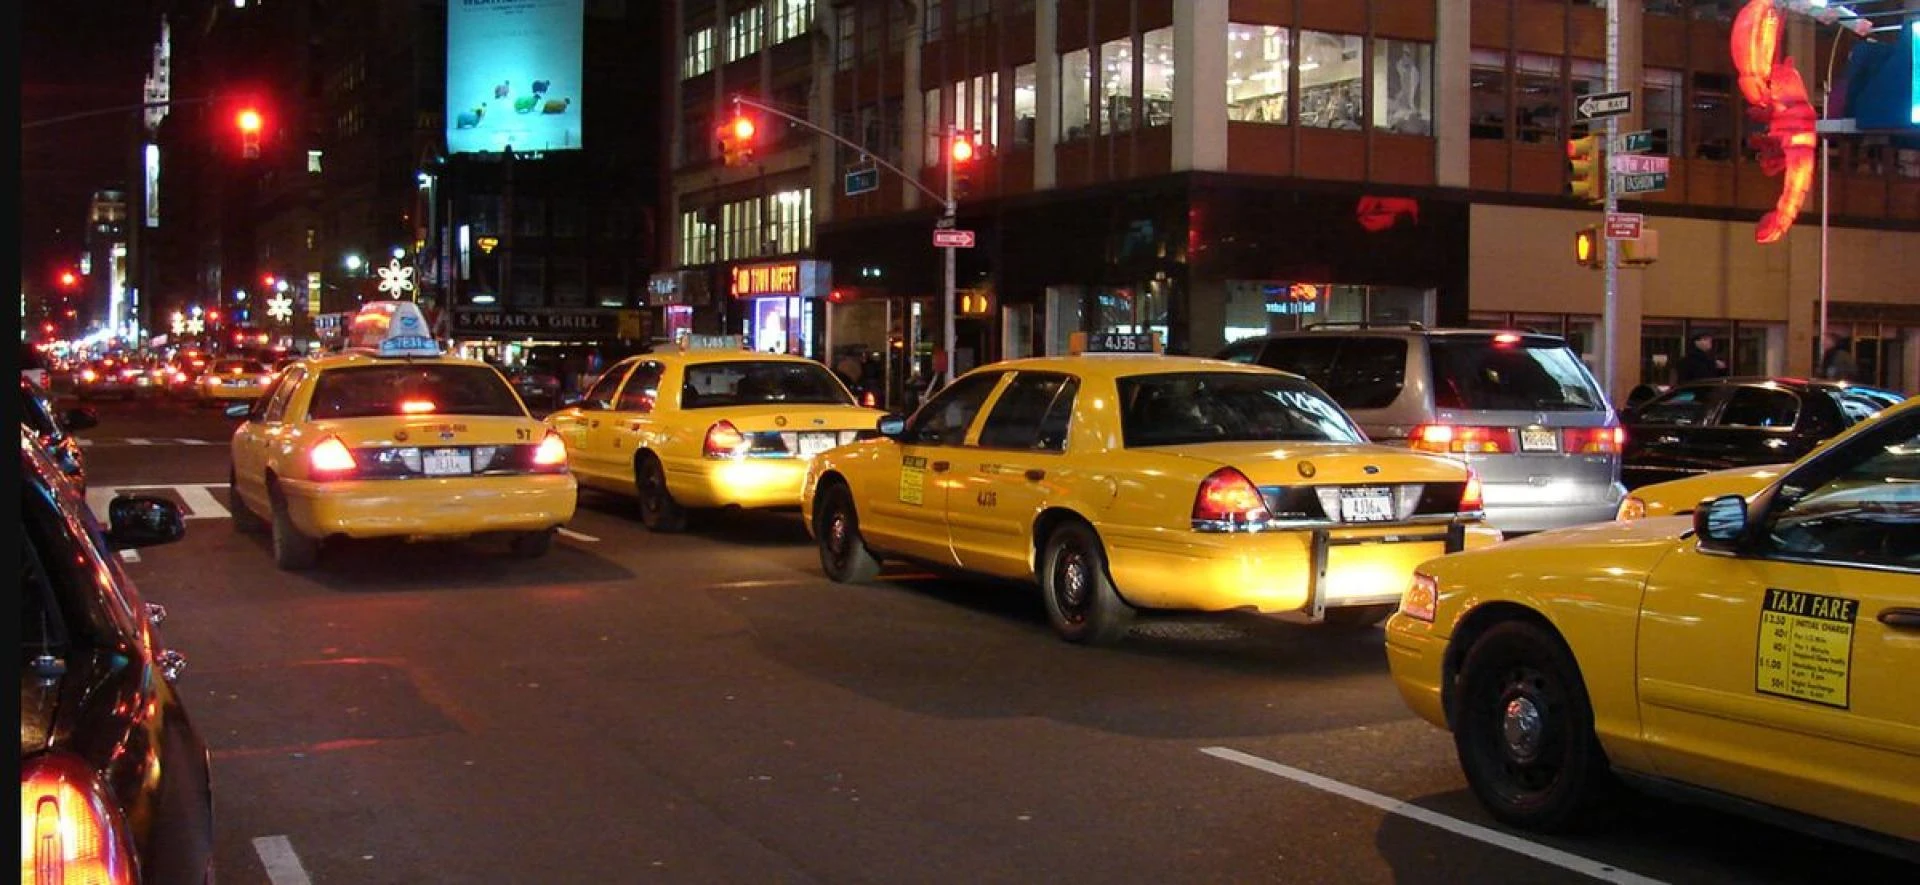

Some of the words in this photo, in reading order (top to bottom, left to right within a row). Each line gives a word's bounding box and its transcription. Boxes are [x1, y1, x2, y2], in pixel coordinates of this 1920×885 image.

[460, 313, 539, 327] SAHARA
[549, 314, 600, 329] GRILL
[1104, 335, 1136, 350] 4J36
[1771, 590, 1808, 614] TAXI
[1811, 596, 1853, 621] FARE
